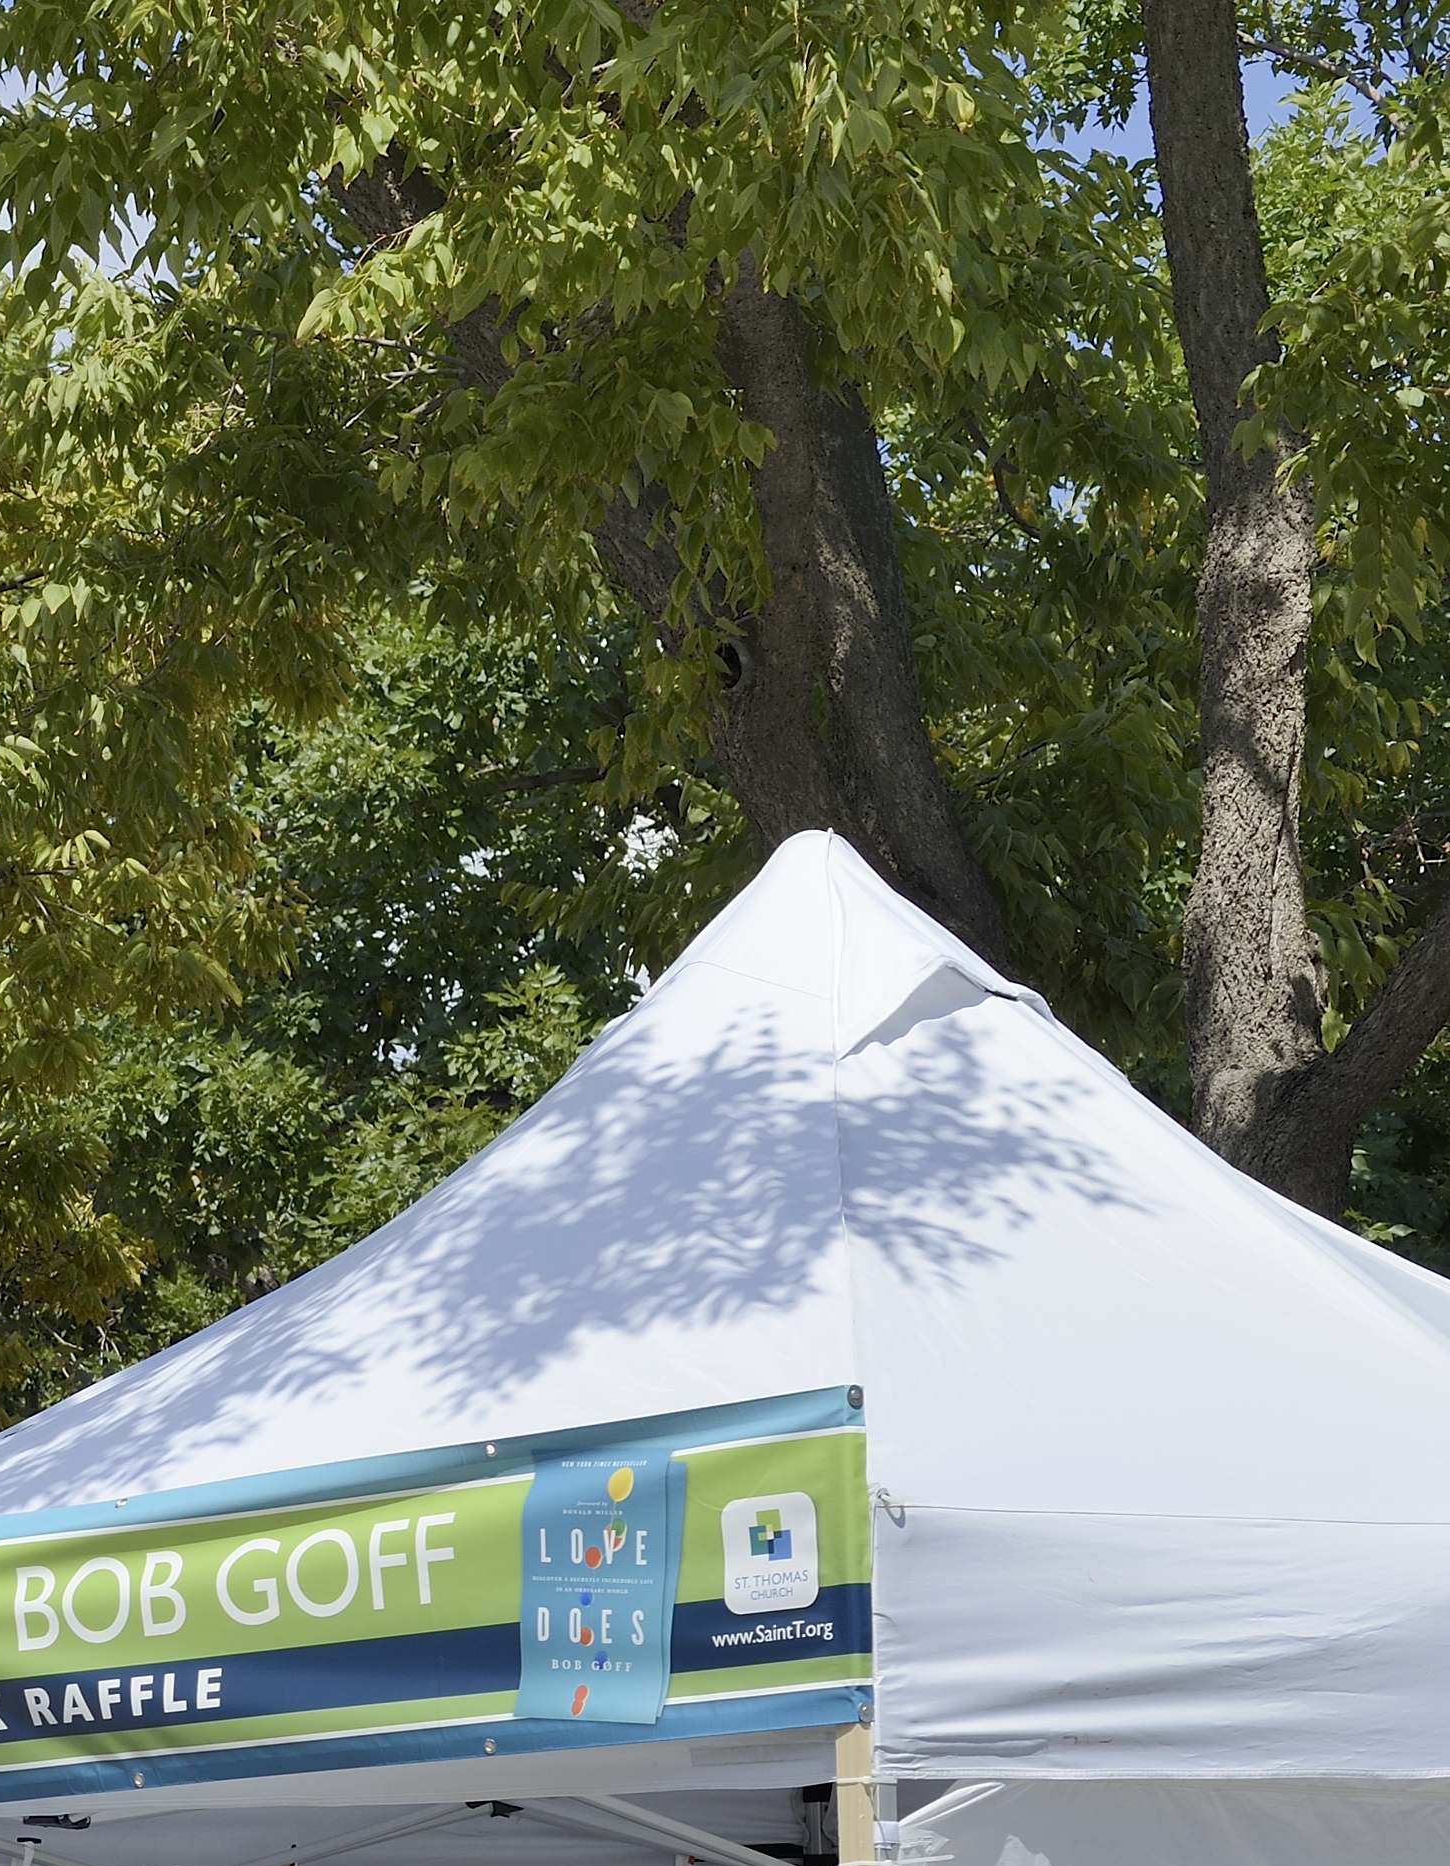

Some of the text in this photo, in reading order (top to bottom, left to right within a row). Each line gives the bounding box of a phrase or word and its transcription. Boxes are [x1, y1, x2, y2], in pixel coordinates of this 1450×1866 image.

[539, 1527, 648, 1566] LOVE
[13, 1550, 187, 1652] BOB
[215, 1510, 458, 1627] GOFF
[734, 1569, 809, 1590] ST. THOMAS
[750, 1586, 794, 1601] CHURCH
[537, 1606, 645, 1646] DOES
[711, 1619, 834, 1648] www.SaintT.org
[551, 1658, 633, 1673] BOB GOFF
[24, 1668, 225, 1728] RAFFLE
